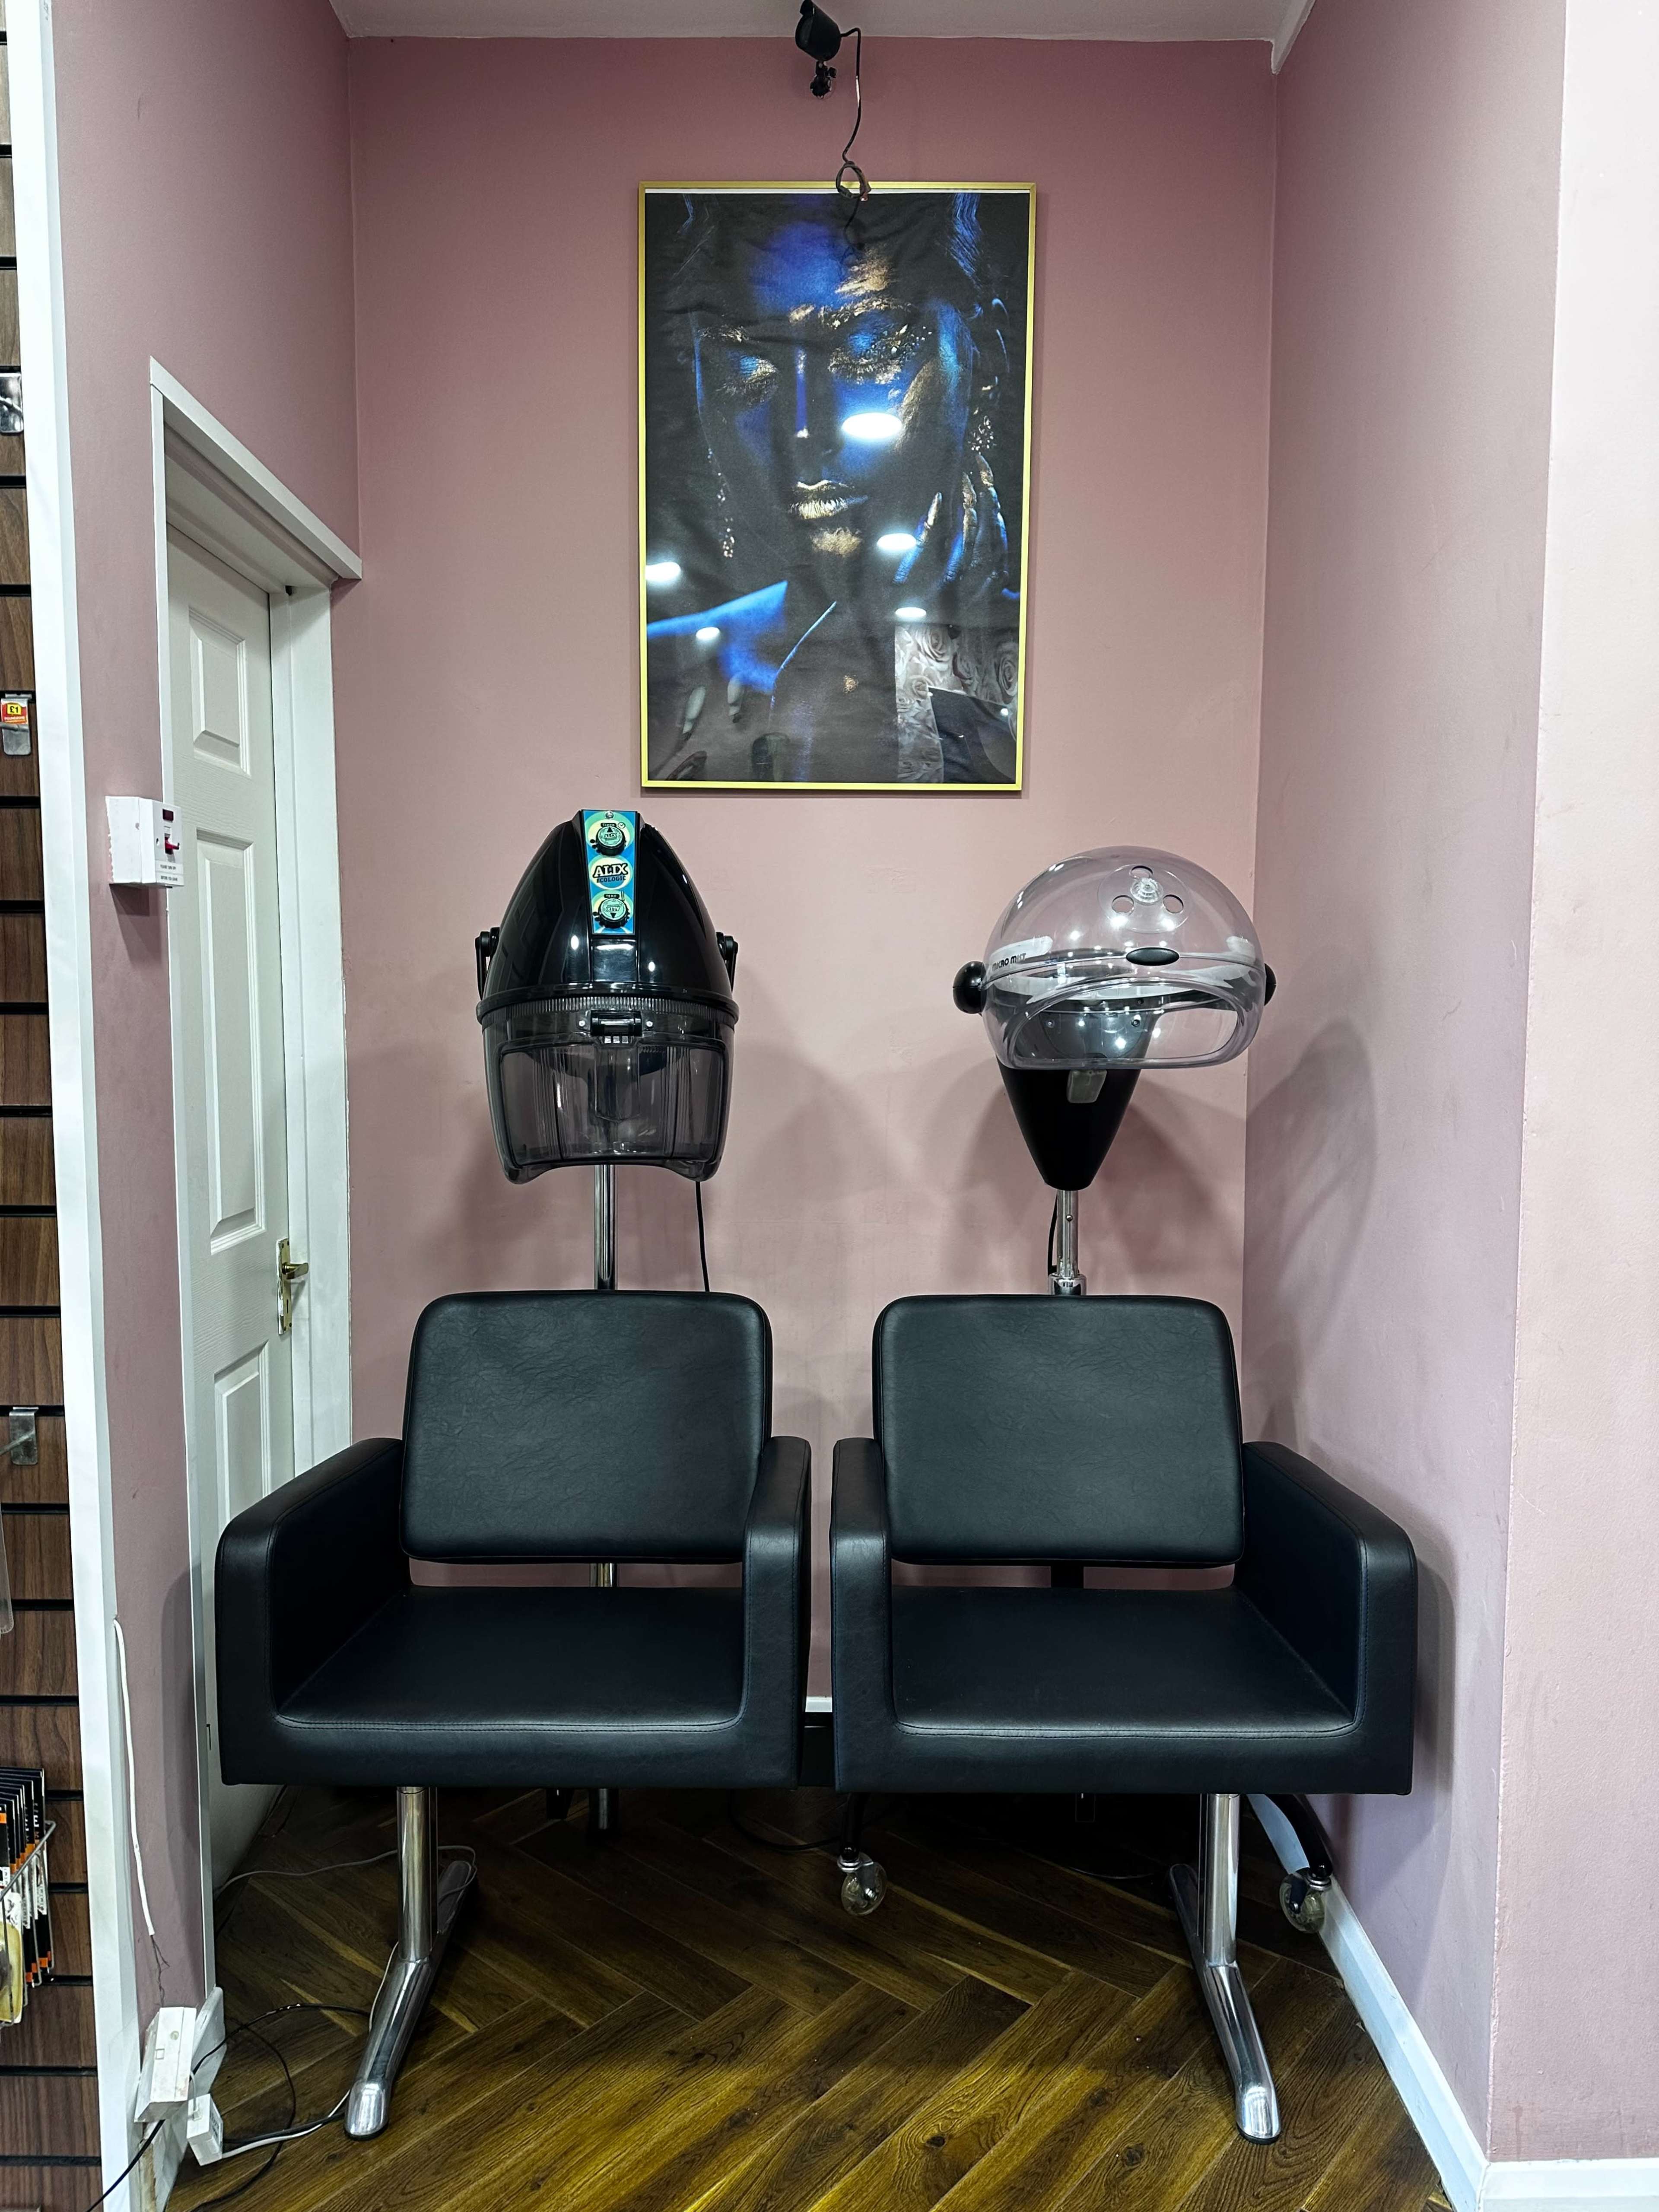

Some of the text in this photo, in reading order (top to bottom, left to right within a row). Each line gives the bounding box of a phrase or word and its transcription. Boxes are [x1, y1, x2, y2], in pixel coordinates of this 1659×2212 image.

[593, 863, 628, 877] ALIX
[992, 953, 1026, 971] MICRO MIST
